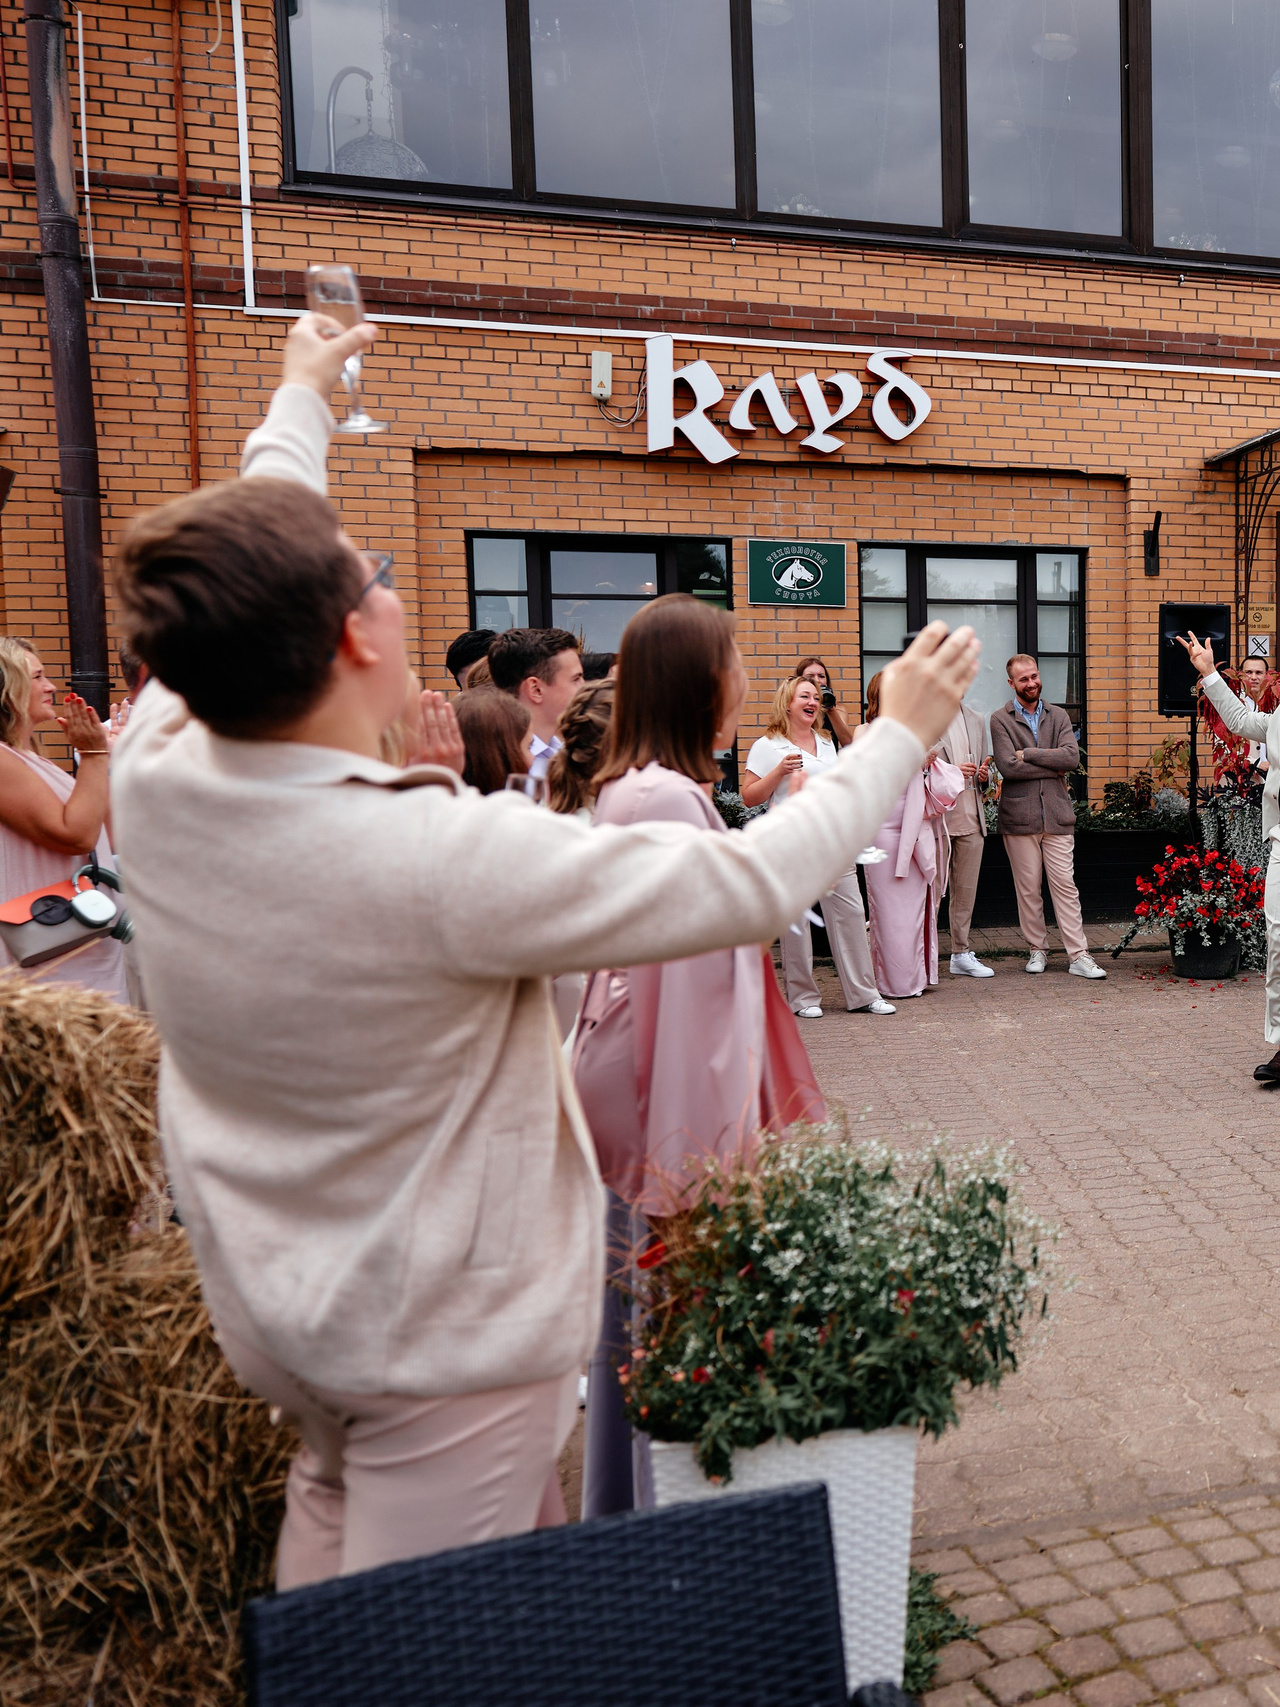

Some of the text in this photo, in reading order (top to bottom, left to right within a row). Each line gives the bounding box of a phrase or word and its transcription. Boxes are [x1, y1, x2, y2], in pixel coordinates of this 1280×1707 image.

[645, 334, 932, 464] Клуб
[766, 546, 828, 566] ТЕХНОЛОГИЯ
[775, 588, 820, 600] СПОРТА
